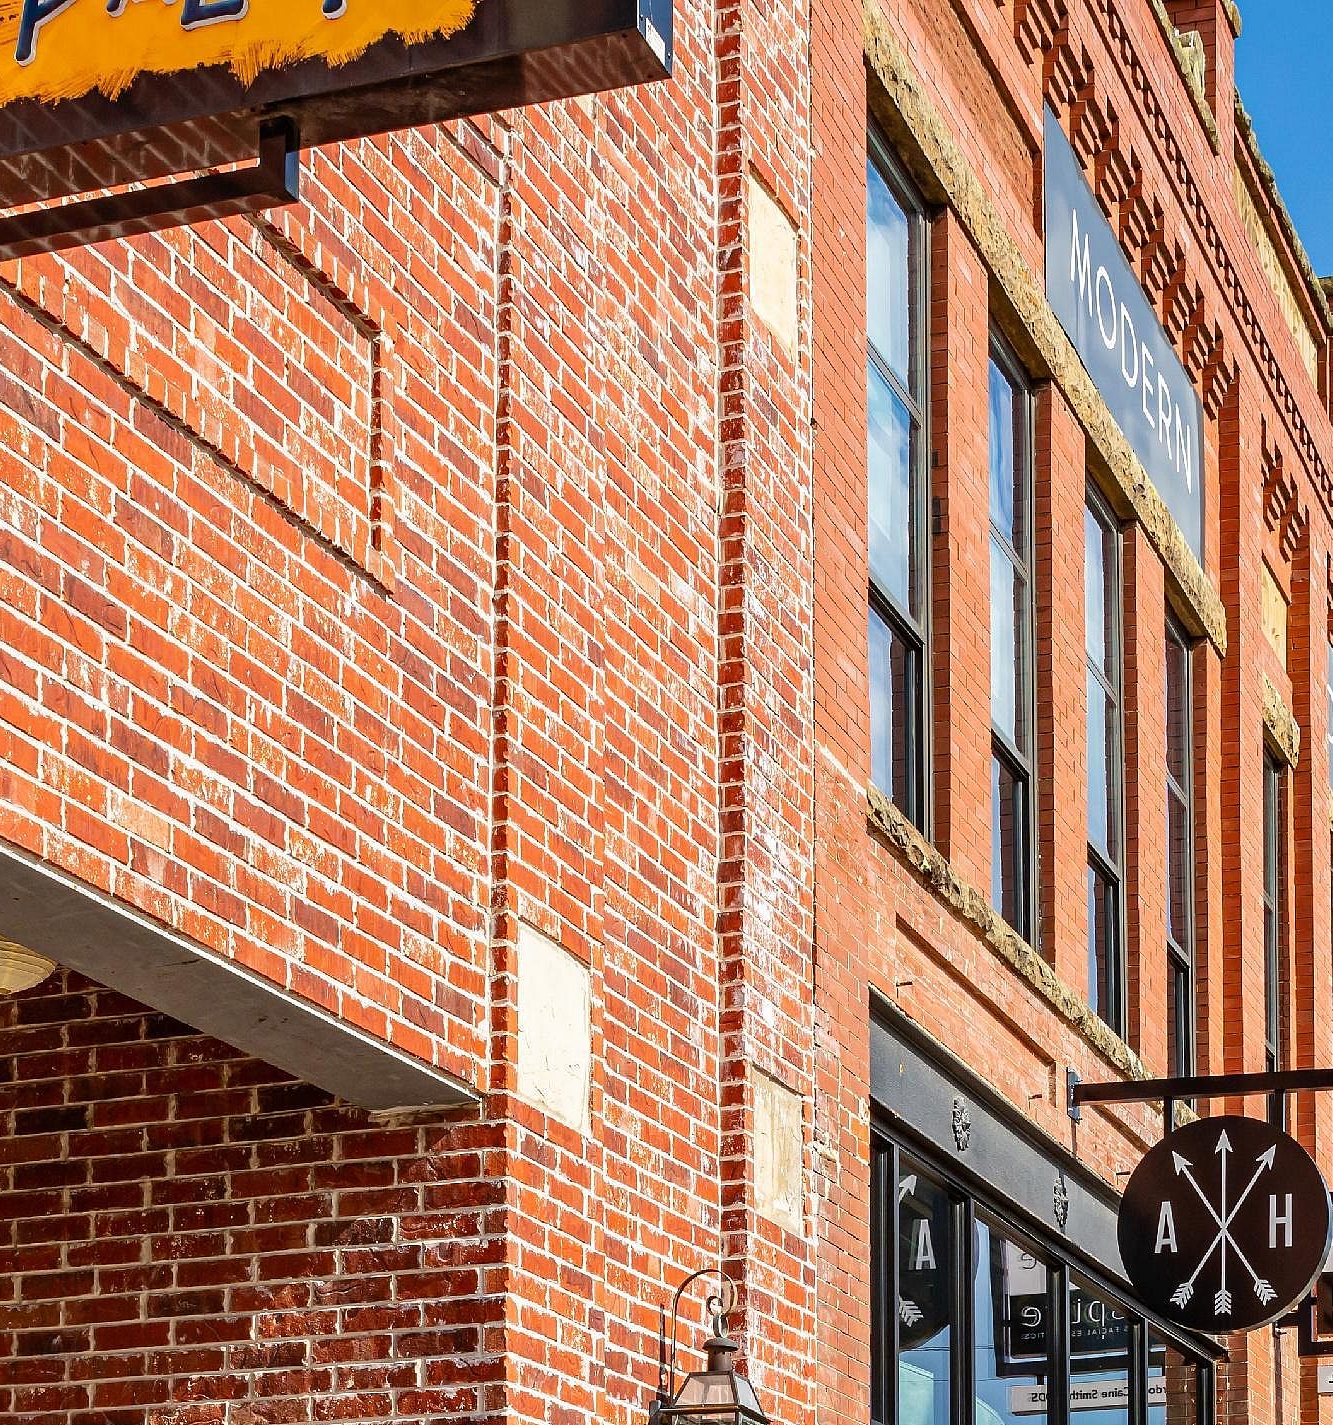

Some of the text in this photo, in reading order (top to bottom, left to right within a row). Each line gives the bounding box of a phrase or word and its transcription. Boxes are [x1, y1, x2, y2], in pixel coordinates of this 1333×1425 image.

[1070, 207, 1193, 495] MODERN
[1154, 1193, 1293, 1254] A H
